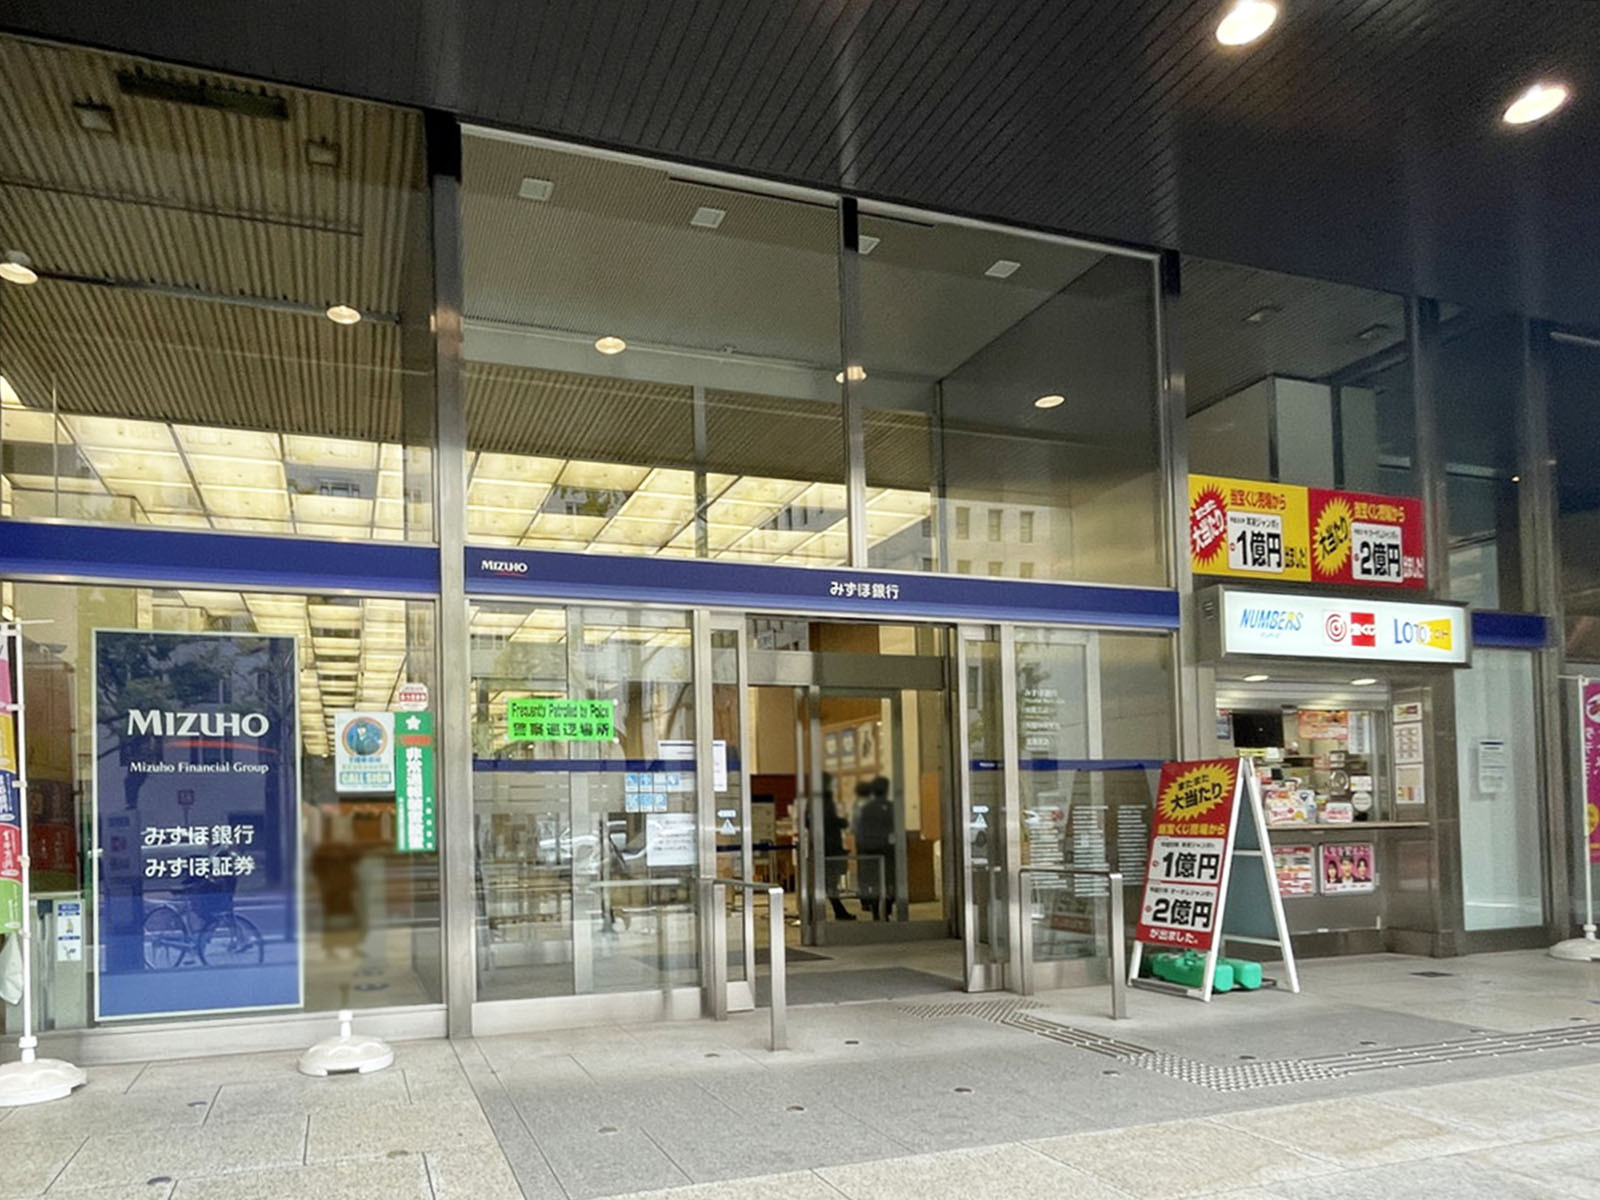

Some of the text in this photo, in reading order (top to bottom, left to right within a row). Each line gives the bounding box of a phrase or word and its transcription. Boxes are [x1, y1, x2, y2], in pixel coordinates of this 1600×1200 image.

[1237, 530, 1282, 568] 1億円
[1360, 541, 1401, 577] 2億円
[481, 560, 528, 573] MIZUHO
[829, 581, 899, 600] みずほ銀行
[1240, 608, 1304, 632] NUMBERS
[127, 709, 269, 737] MIZUHO
[130, 761, 269, 775] Mizuho Financial Group
[1171, 782, 1222, 812] 大当たり
[144, 825, 254, 846] みずほ銀行
[145, 857, 255, 878] みずほ証券
[1163, 852, 1219, 880] 1億円
[1152, 898, 1212, 928] 2億円
